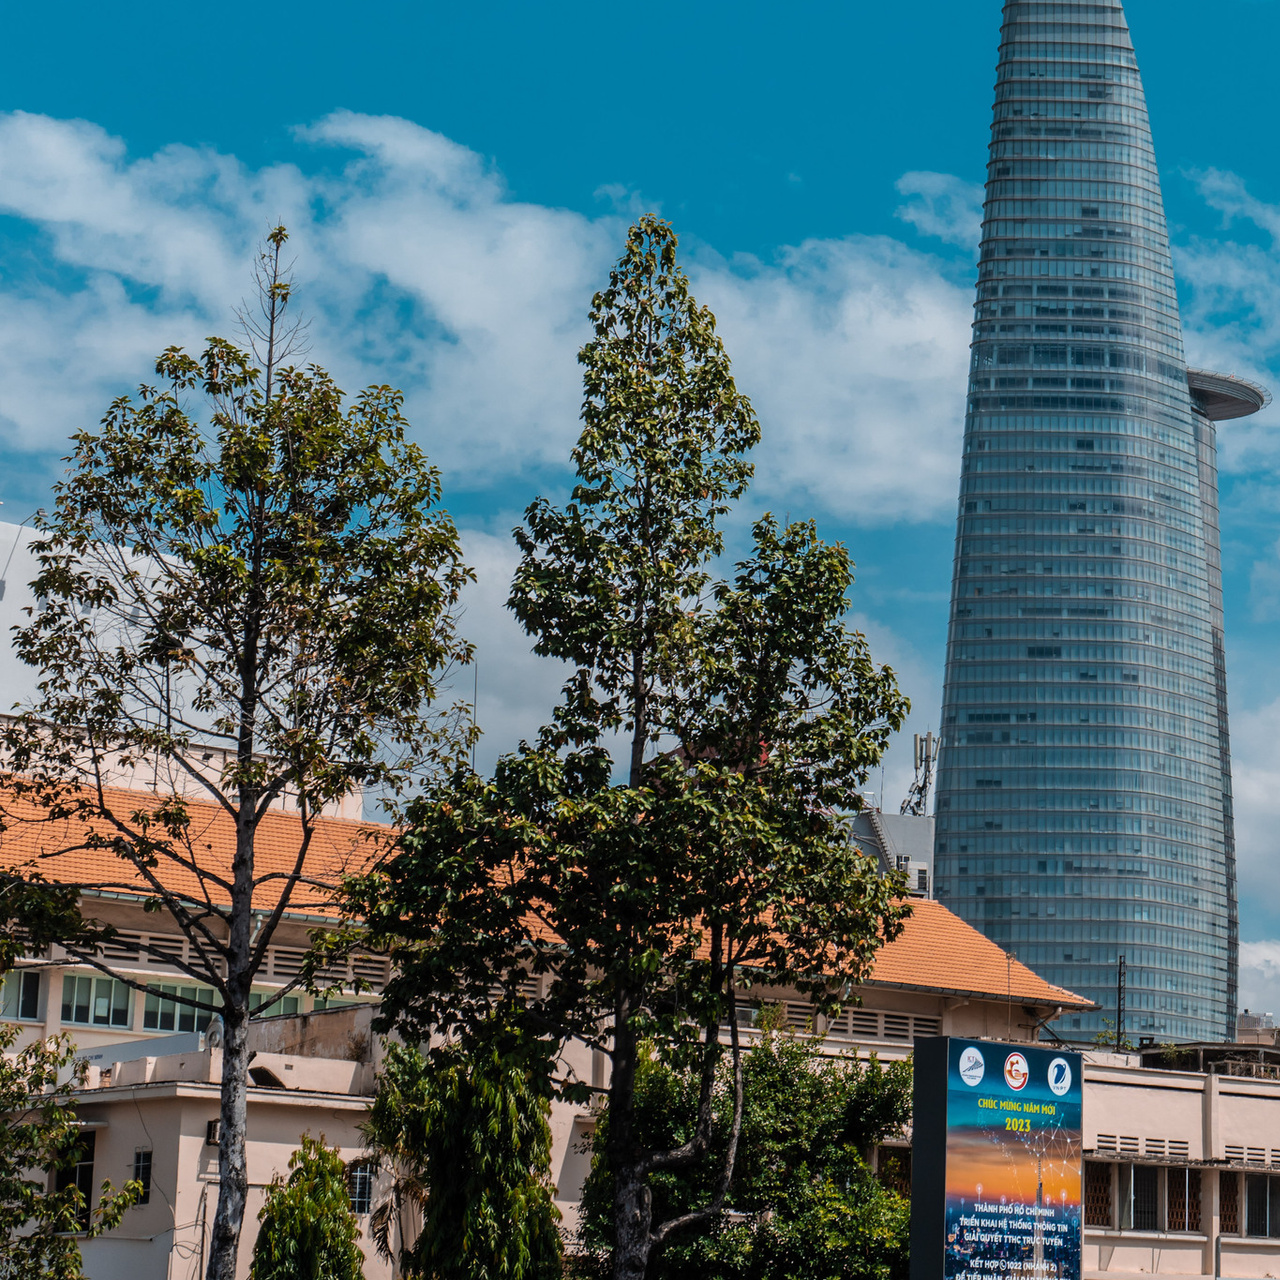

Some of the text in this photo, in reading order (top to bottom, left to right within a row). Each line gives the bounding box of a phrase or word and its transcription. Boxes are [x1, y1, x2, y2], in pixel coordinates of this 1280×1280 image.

[978, 1097, 1056, 1115] CHÚC MỪNG NĂM MỚI
[1006, 1118, 1031, 1132] 2023
[974, 1202, 1054, 1217] THÀNH PHỐ HỒ CHÍ MINH
[960, 1215, 1068, 1232] TRIỂN KHAI HỆ THỐNG THÔNG TIN
[964, 1231, 1063, 1246] GIẢI QUYẾT TTHC TRỰC TUYẾN
[970, 1257, 983, 1268] KẾT
[985, 1260, 999, 1270] HỢP
[1007, 1261, 1022, 1270] 1022
[1051, 1263, 1057, 1271] 2)
